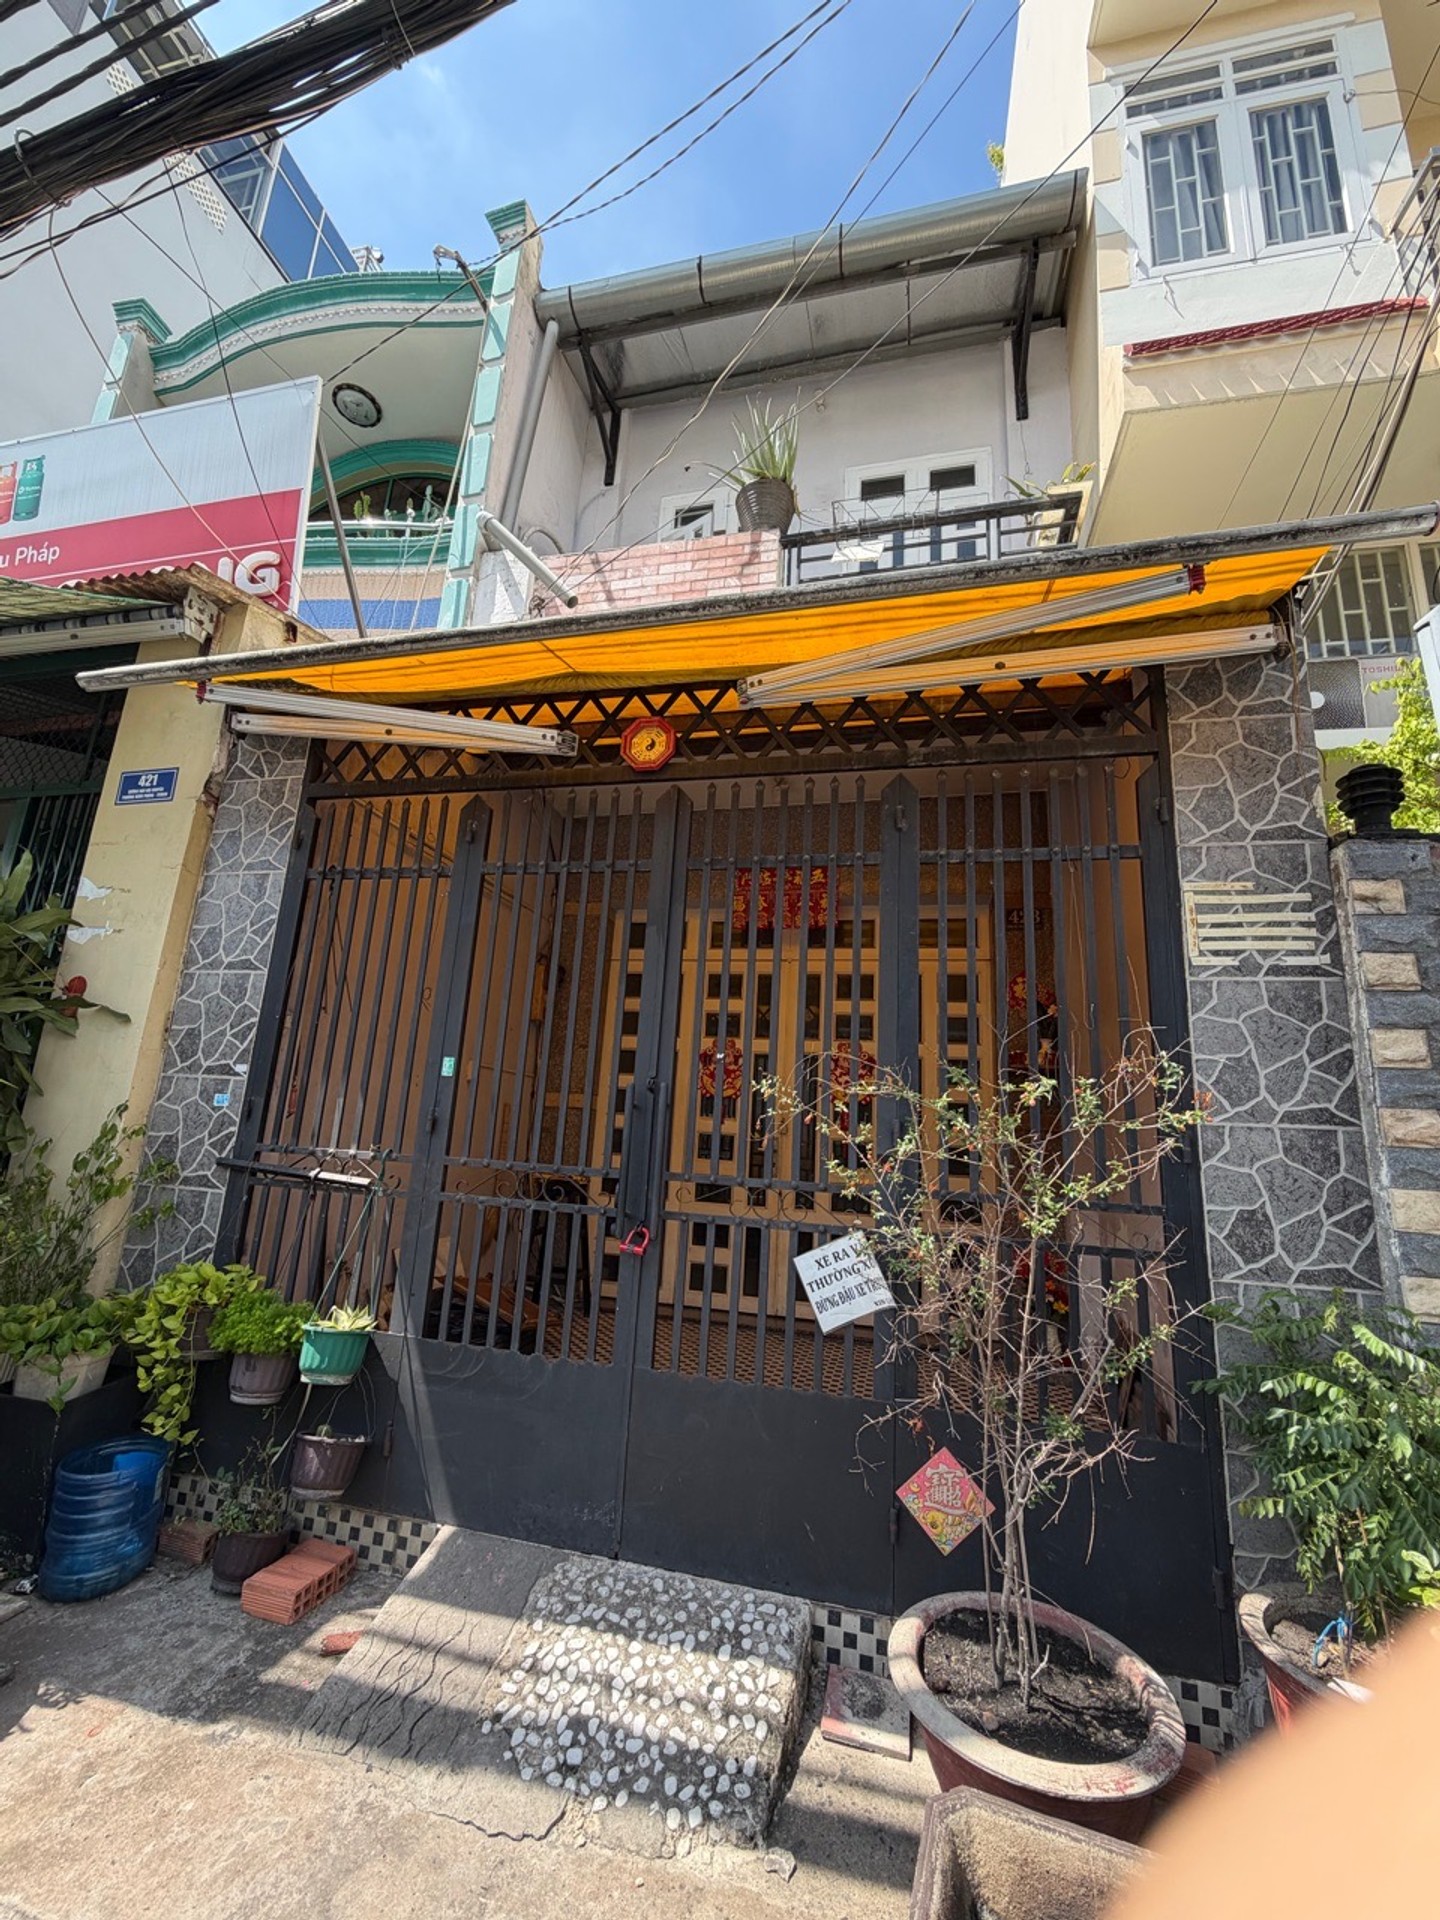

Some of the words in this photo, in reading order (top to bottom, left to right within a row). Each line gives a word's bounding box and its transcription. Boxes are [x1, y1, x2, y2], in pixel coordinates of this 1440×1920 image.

[14, 541, 60, 567] Pháp
[1361, 664, 1404, 674] TOSHI
[138, 773, 159, 787] 421
[814, 1254, 833, 1271] XE
[831, 1247, 851, 1263] RA
[806, 1262, 861, 1293] THƯỜNG
